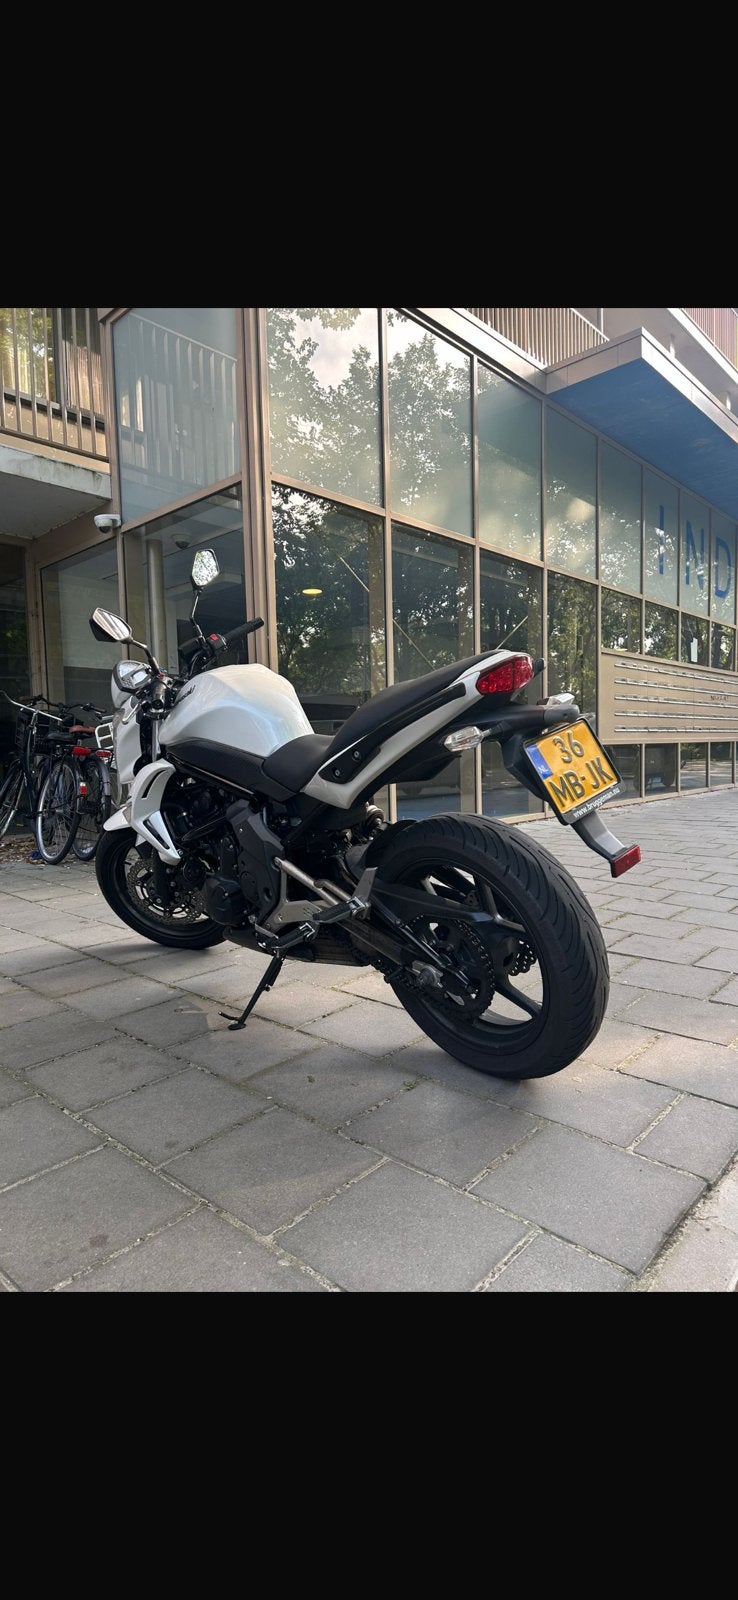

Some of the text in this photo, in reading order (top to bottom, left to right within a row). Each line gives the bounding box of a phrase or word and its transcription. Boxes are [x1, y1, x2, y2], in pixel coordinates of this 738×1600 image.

[658, 505, 733, 599] IND
[552, 730, 585, 763] 36
[539, 765, 549, 774] NL
[549, 756, 613, 807] MB-JK
